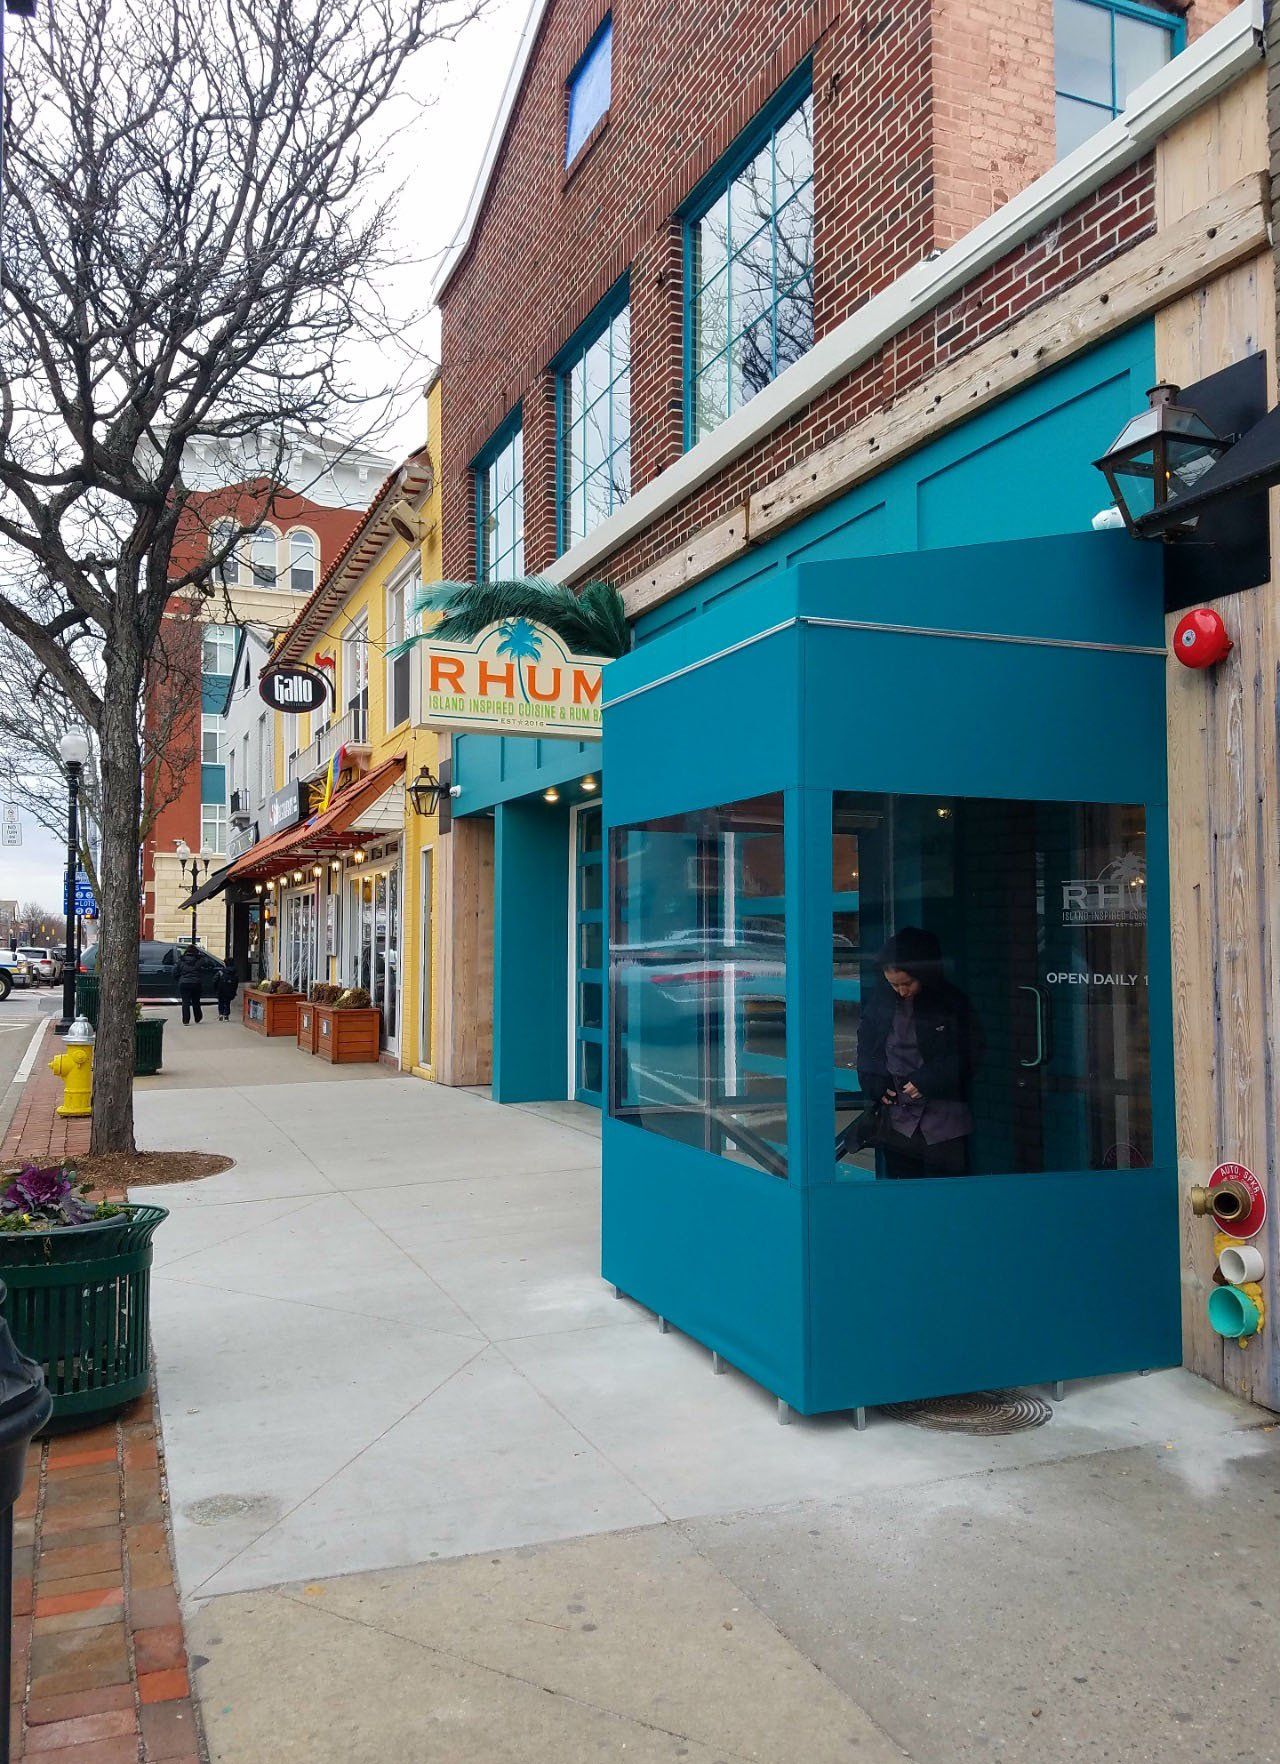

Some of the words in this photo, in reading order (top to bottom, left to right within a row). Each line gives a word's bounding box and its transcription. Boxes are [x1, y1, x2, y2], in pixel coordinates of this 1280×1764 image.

[274, 675, 312, 704] Gallo
[429, 655, 602, 704] RHUM
[429, 695, 465, 711] ISLAND
[469, 699, 514, 716] INSPIRED
[519, 703, 556, 719] CUISINE
[560, 708, 566, 719] &
[570, 708, 590, 721] RUM
[1046, 972, 1089, 985] OPEN
[1093, 973, 1139, 986] DAILY
